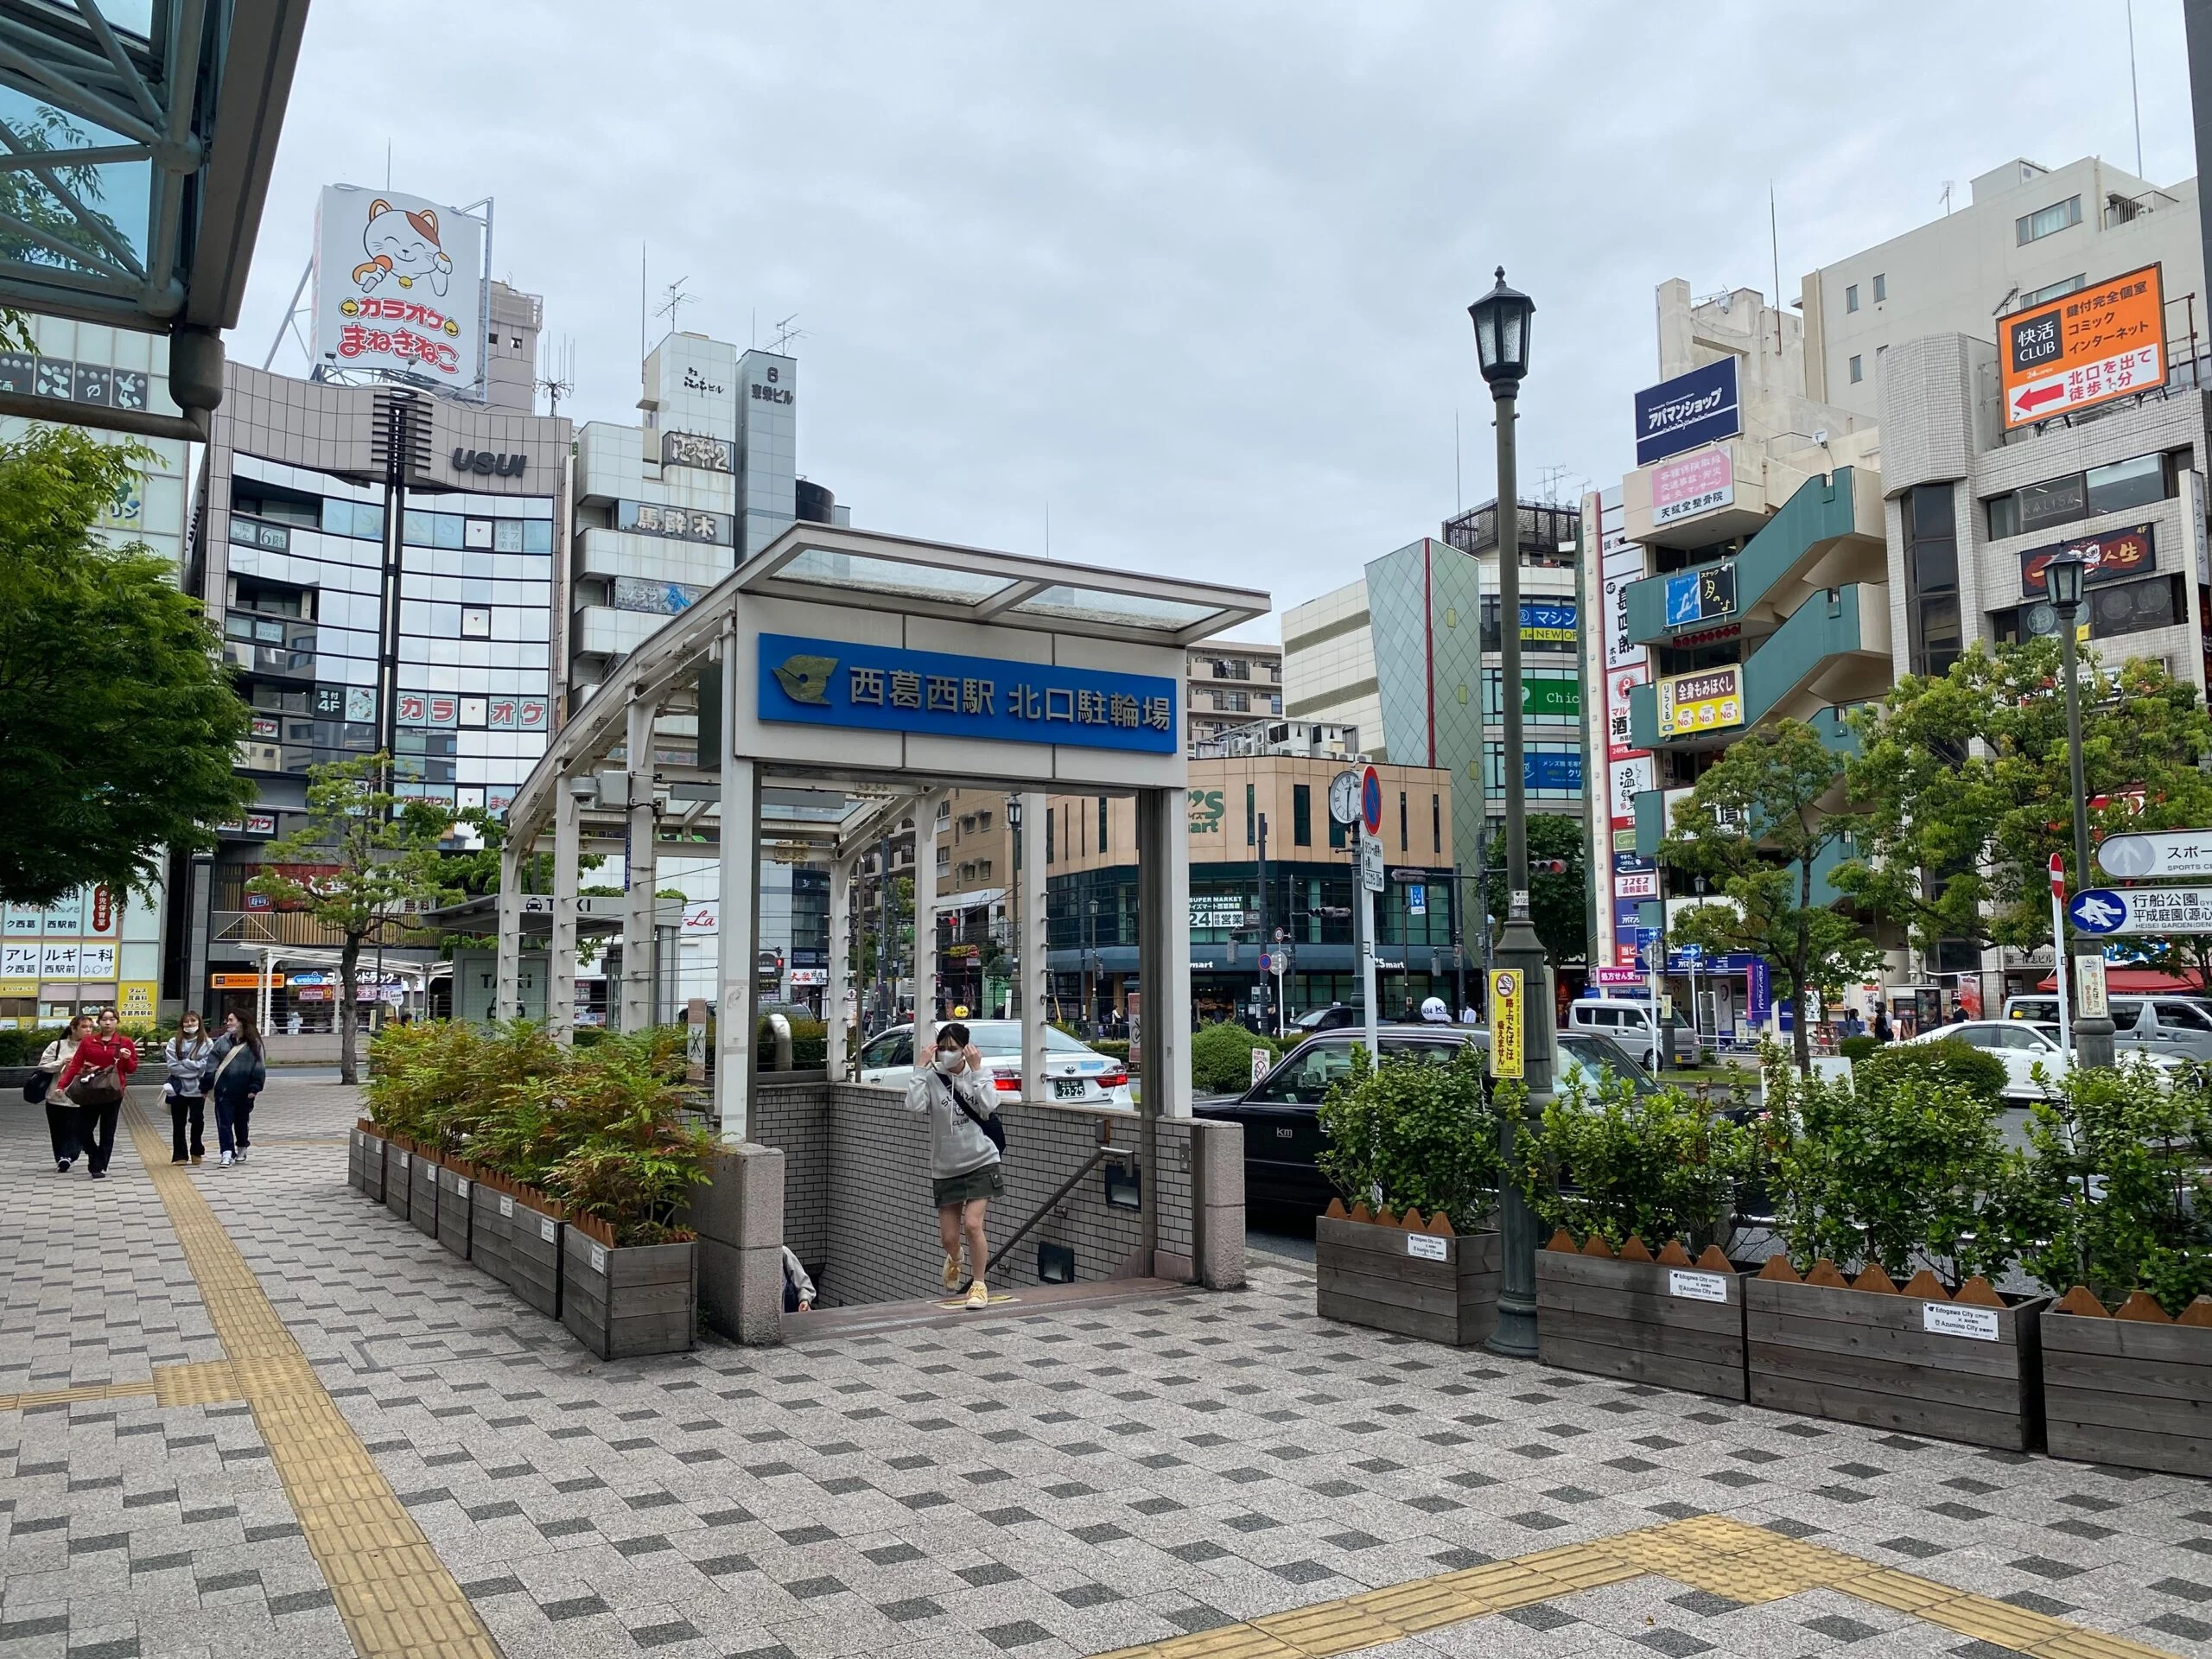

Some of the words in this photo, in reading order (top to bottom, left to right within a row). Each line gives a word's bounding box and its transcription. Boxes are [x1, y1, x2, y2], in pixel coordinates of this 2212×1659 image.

[2066, 281, 2148, 319] 鍵付完全個室
[359, 296, 446, 332] カラオケ
[2068, 311, 2116, 336] コミック
[2018, 321, 2055, 346] 快活
[2069, 321, 2150, 355] インターネット
[337, 322, 460, 374] まねきねこ
[2019, 340, 2056, 362] CLUB
[2069, 349, 2152, 386] 北口を出て
[1649, 388, 1722, 429] アパマンショップ
[452, 448, 528, 477] USUI
[2024, 496, 2075, 514] RALISA
[2136, 525, 2148, 535] 4F
[262, 531, 284, 549] 6階
[2102, 542, 2140, 563] 人生
[1701, 569, 1719, 580] スナック
[1535, 630, 1560, 641] NEW
[1609, 647, 1617, 664] 本店
[320, 690, 338, 700] 受付
[1678, 676, 1734, 702] 全身もみほぐし
[318, 699, 340, 712] 4F
[849, 665, 996, 716] 西葛西駅
[1007, 683, 1171, 732] 北口駐輪場
[397, 695, 547, 726] カラオケ
[1699, 713, 1716, 723] No.1
[1720, 709, 1738, 719] No.1
[1612, 716, 1631, 736] 酒
[1678, 716, 1694, 726] No.1
[1188, 819, 1218, 834] art
[1622, 876, 1649, 886] コスモス
[2133, 893, 2198, 907] 行船公園
[6, 949, 113, 963] アレルギー科
[5, 965, 76, 974] ク西葛西駅前
[1506, 998, 1515, 1061] 路上でたばこは
[1276, 1128, 1293, 1136] km
[1936, 1306, 1961, 1315] Edogawa
[1961, 1310, 1974, 1319] City
[1941, 1320, 1965, 1329] Azumino
